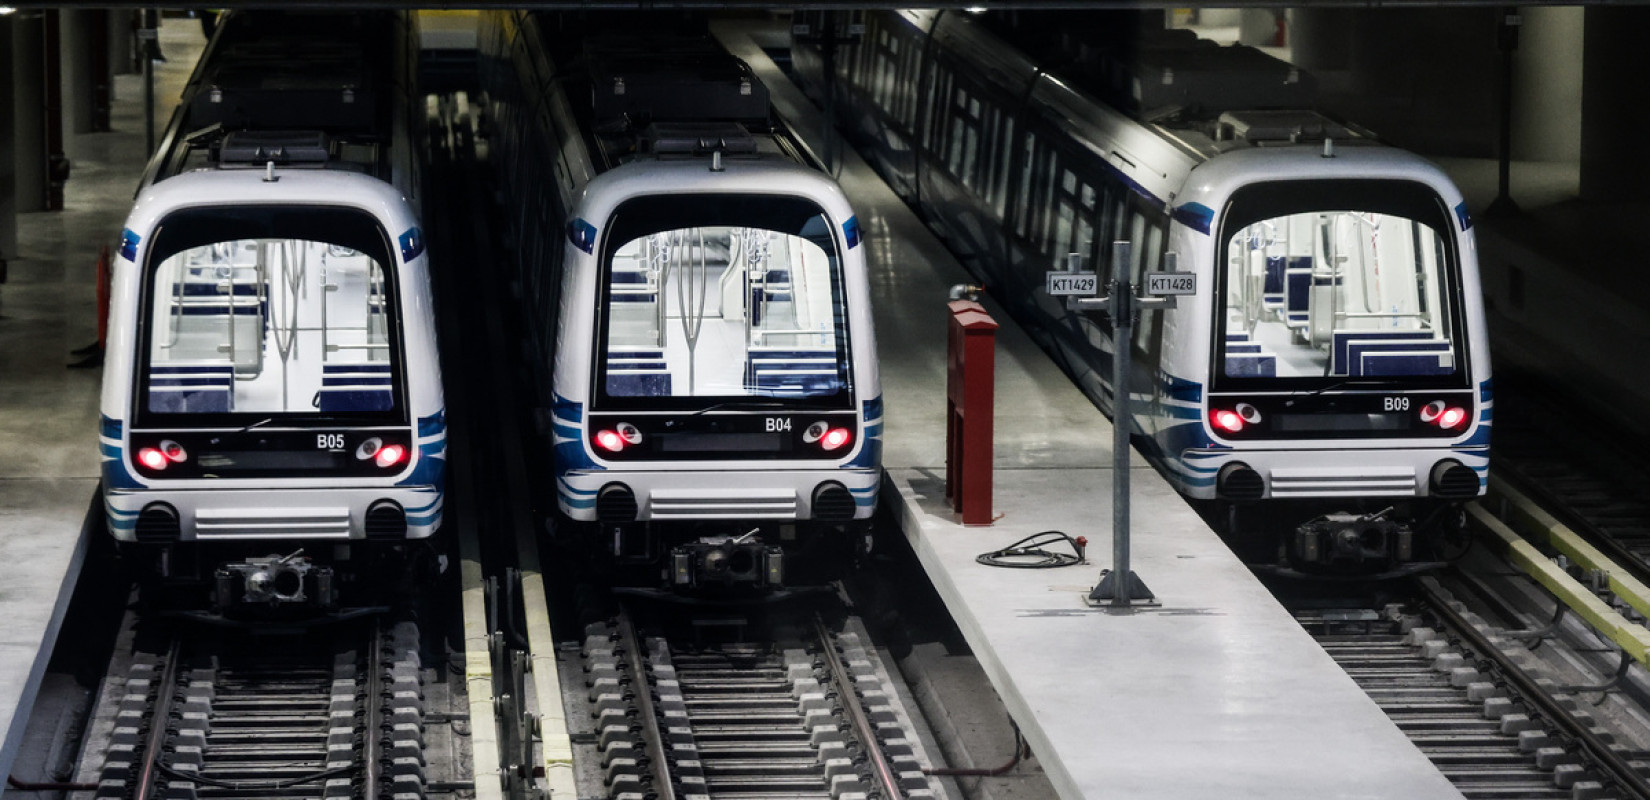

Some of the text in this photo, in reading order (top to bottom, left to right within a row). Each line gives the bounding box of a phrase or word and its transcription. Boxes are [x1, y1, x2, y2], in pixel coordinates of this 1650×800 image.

[1052, 279, 1094, 291] KT1429
[1151, 278, 1193, 290] KT1428
[1384, 397, 1409, 411] B09
[765, 417, 792, 432] B04
[317, 433, 345, 449] B05
